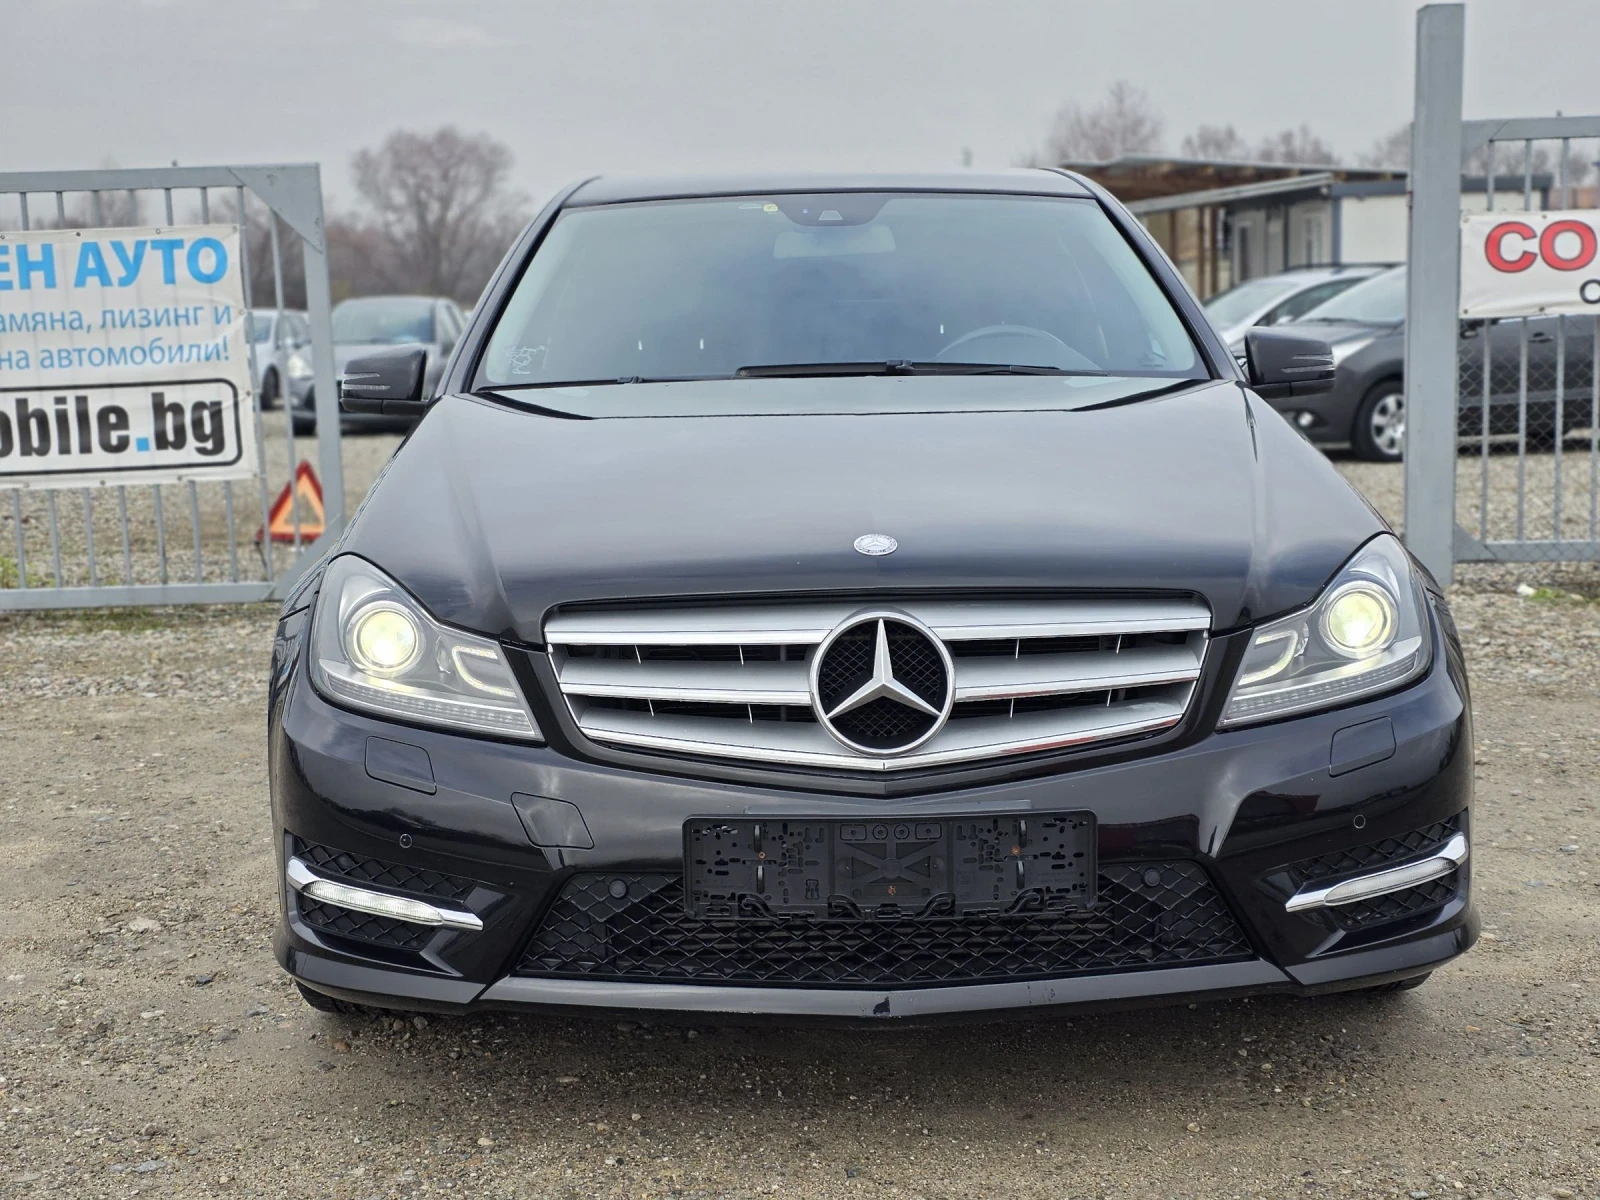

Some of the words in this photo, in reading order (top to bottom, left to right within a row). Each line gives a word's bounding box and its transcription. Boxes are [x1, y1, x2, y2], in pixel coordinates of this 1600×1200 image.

[73, 237, 229, 288] АУТО
[100, 305, 204, 329] лизинг
[214, 305, 232, 325] и
[0, 349, 30, 370] на
[39, 336, 230, 369] автомобили!
